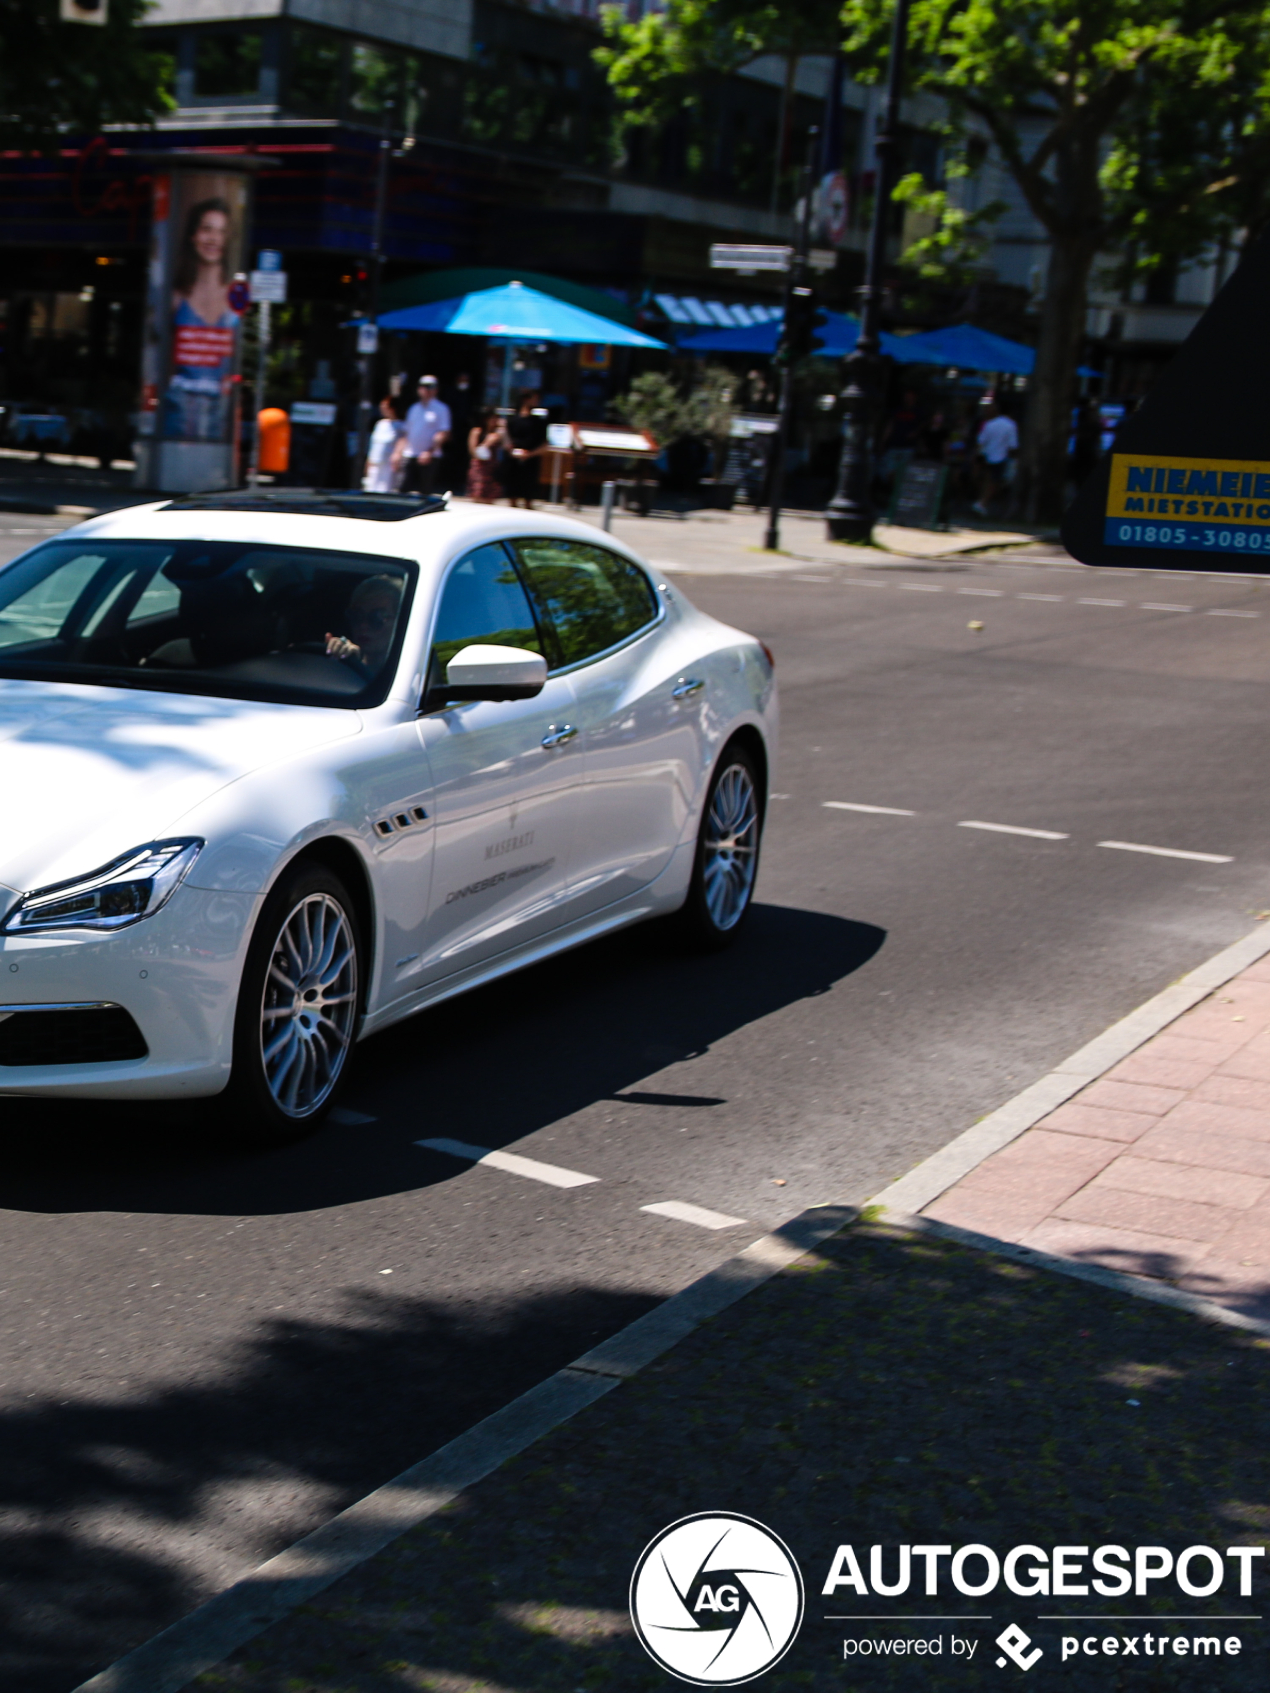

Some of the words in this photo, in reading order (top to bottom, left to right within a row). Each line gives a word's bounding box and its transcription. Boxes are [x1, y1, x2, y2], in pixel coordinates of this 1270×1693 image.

[1124, 497, 1270, 519] MIETSTATIO
[484, 831, 536, 861] MASERATI
[445, 871, 507, 905] DINNEBIER
